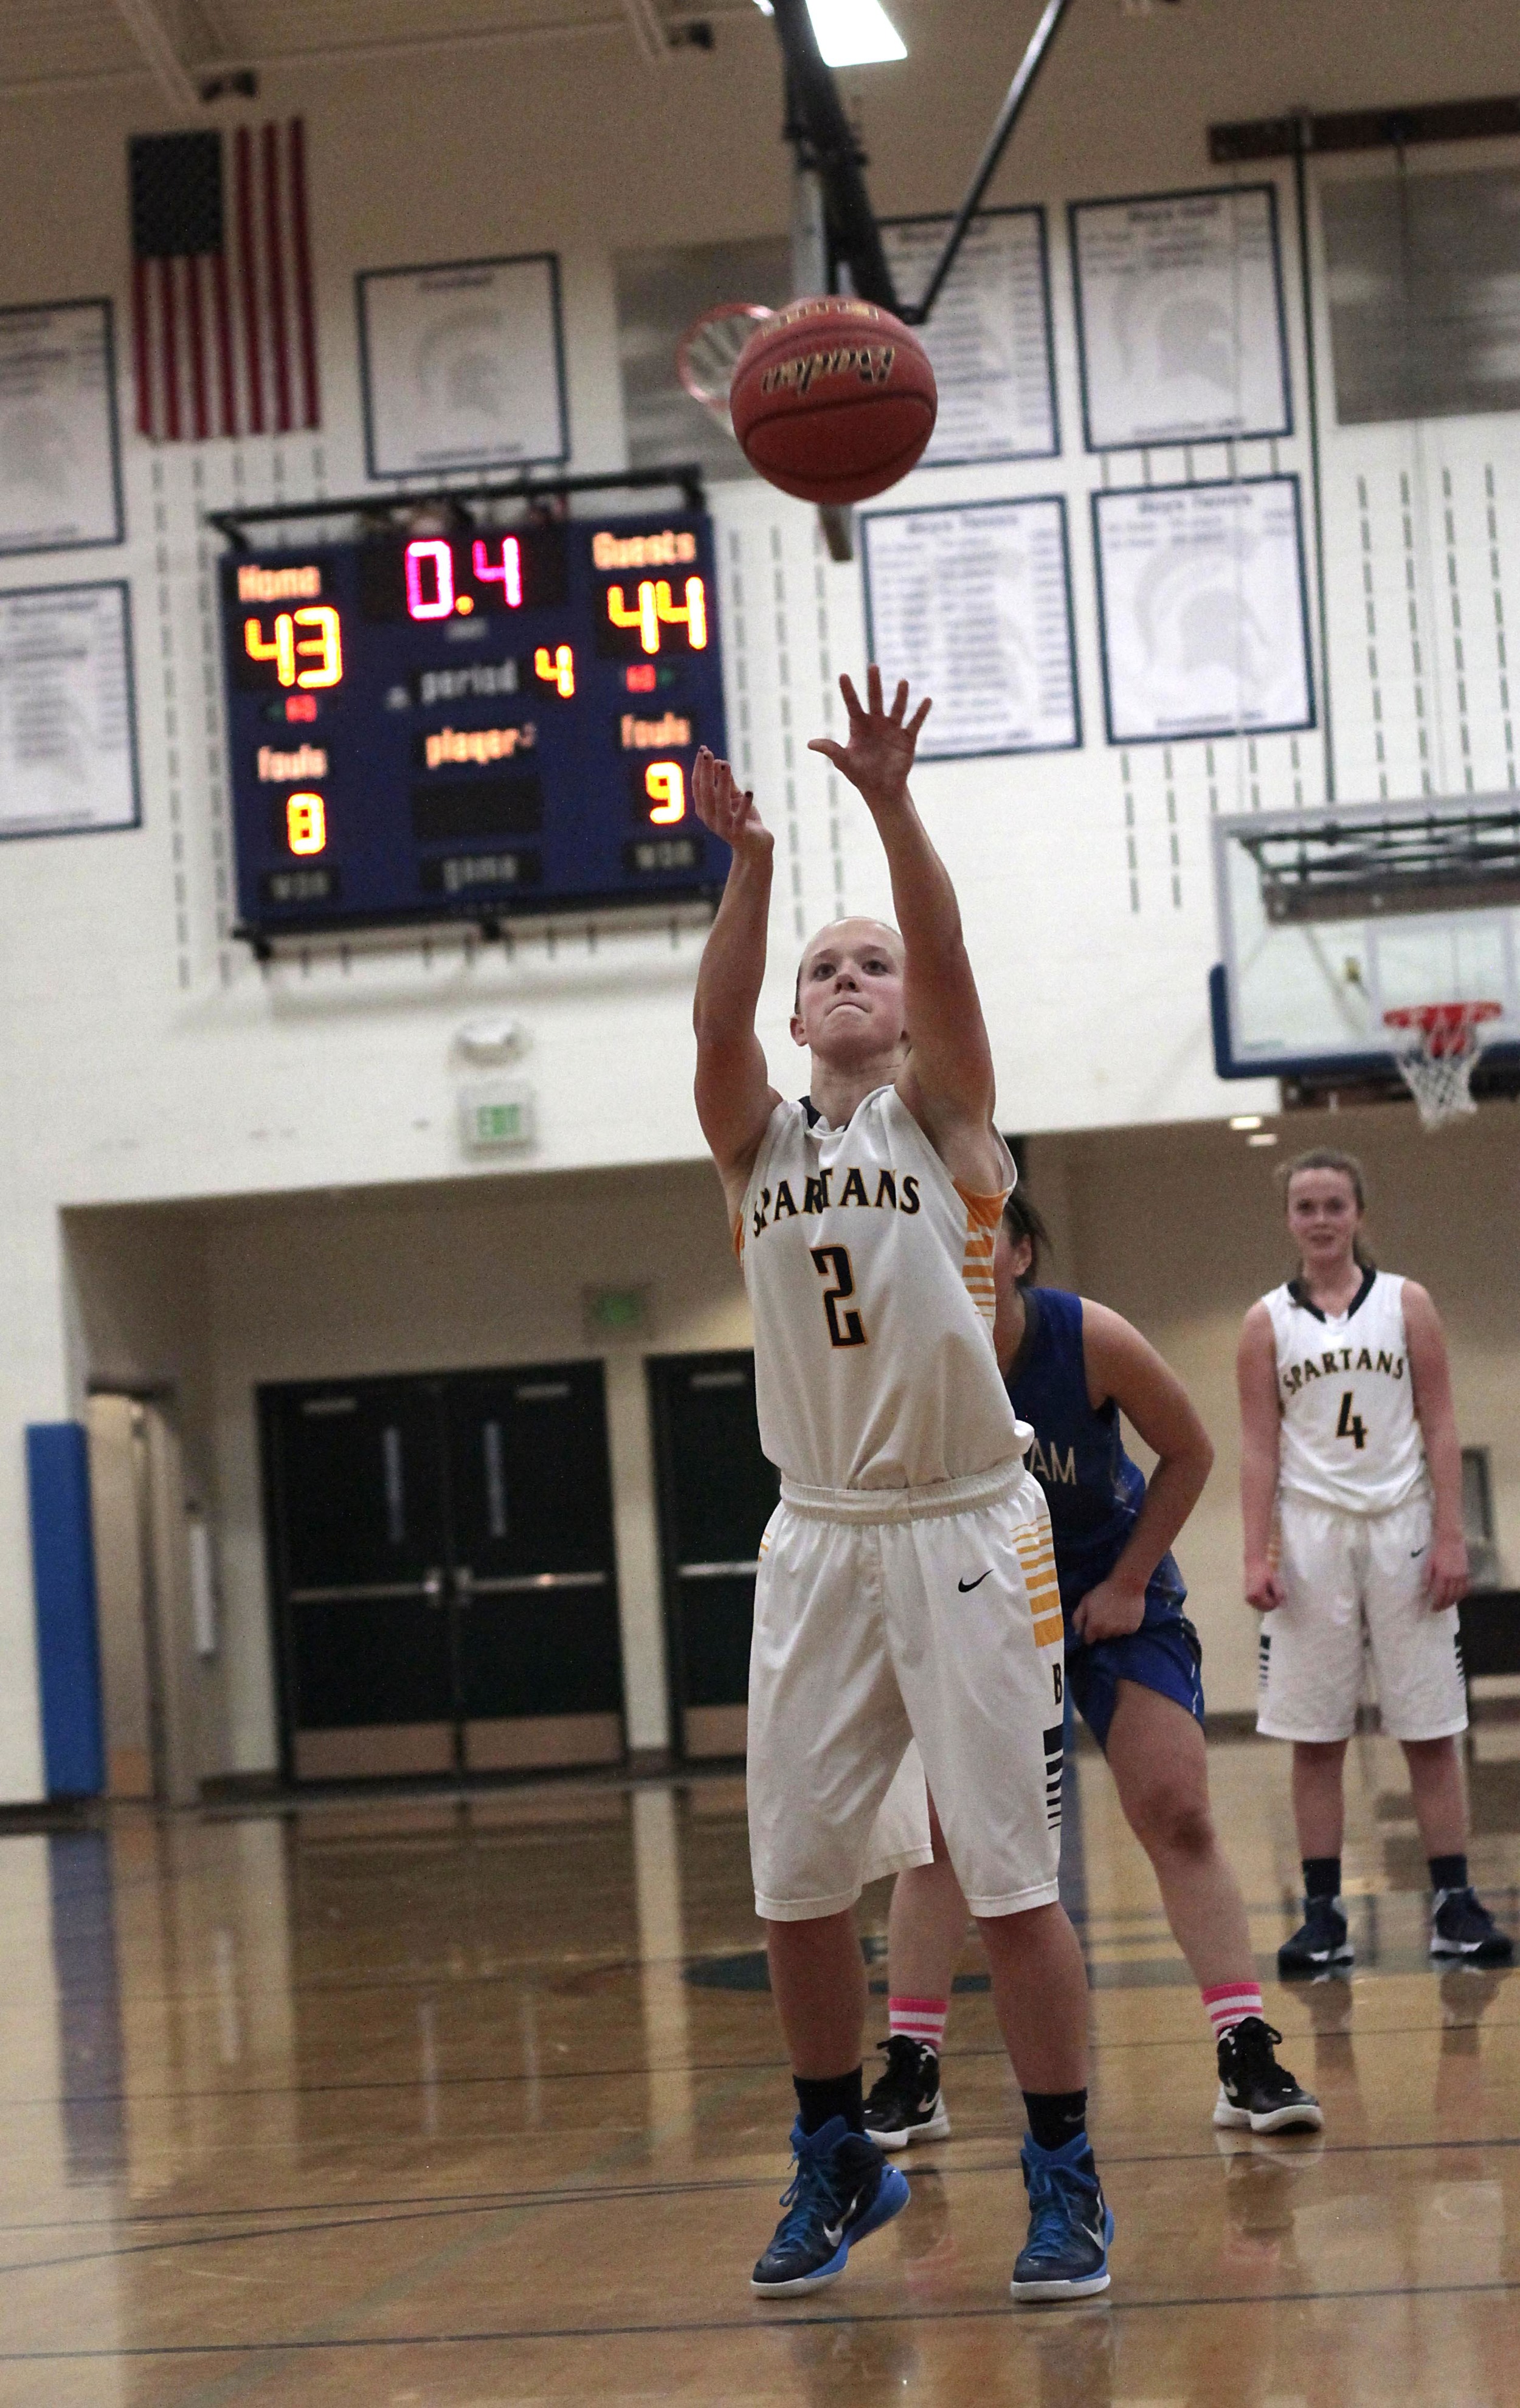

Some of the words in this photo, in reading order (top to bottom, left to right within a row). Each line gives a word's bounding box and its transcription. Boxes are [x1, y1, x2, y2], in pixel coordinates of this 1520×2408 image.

[404, 536, 522, 621] 0.4
[593, 530, 696, 571] Guests
[238, 565, 322, 603] Home
[607, 576, 707, 654] 44
[244, 605, 343, 689] 43
[421, 658, 519, 706] period
[534, 644, 575, 699] 4
[621, 711, 691, 750] fouls
[258, 742, 328, 783] fouls
[645, 760, 685, 825] 9
[286, 792, 326, 856] 8
[753, 1167, 921, 1238] SPARTANS
[810, 1243, 868, 1349] 2
[1283, 1347, 1404, 1395] SPARTANS
[1335, 1390, 1367, 1450] 4
